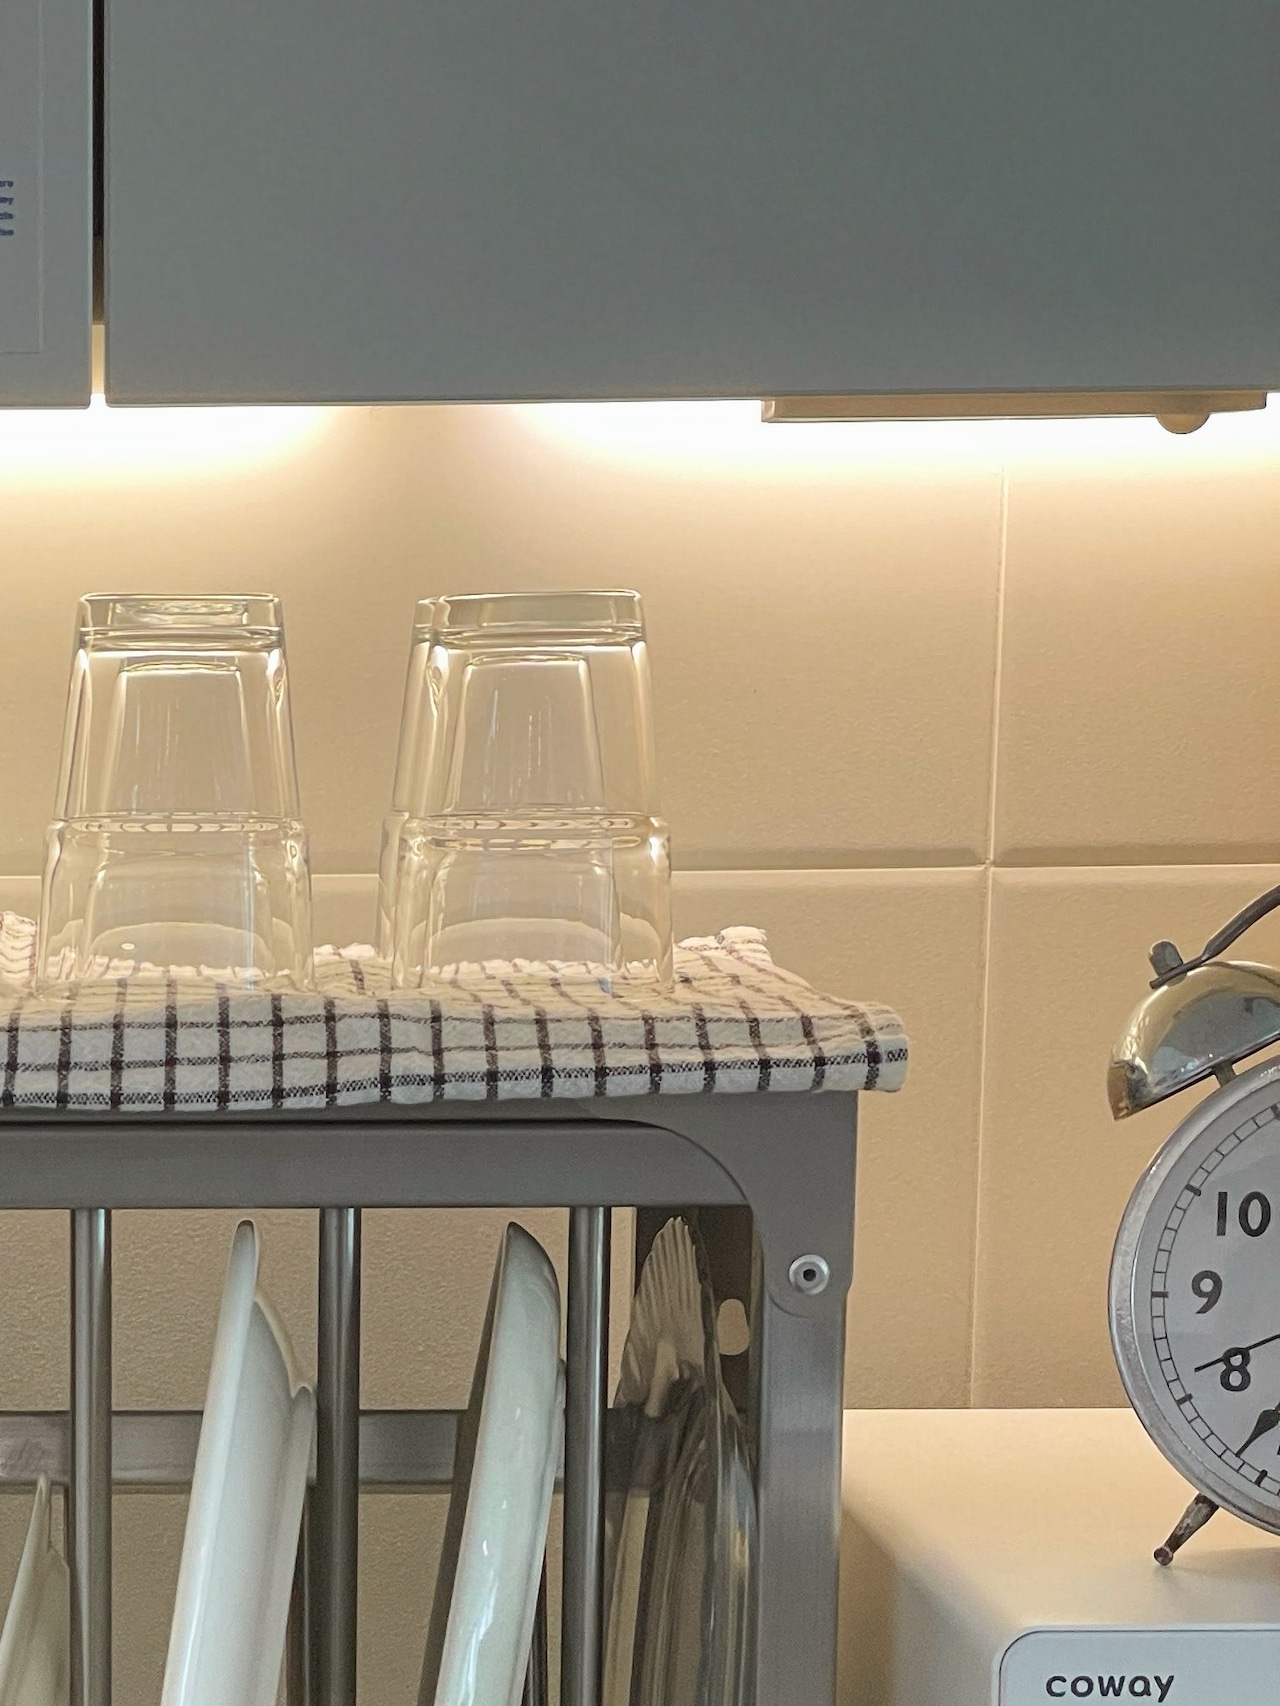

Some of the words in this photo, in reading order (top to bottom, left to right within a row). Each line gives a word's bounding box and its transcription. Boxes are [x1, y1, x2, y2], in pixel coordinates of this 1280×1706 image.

[1216, 1191, 1272, 1238] 10
[1191, 1270, 1223, 1315] 9
[1220, 1346, 1252, 1392] 8
[1046, 1674, 1175, 1703] coway
